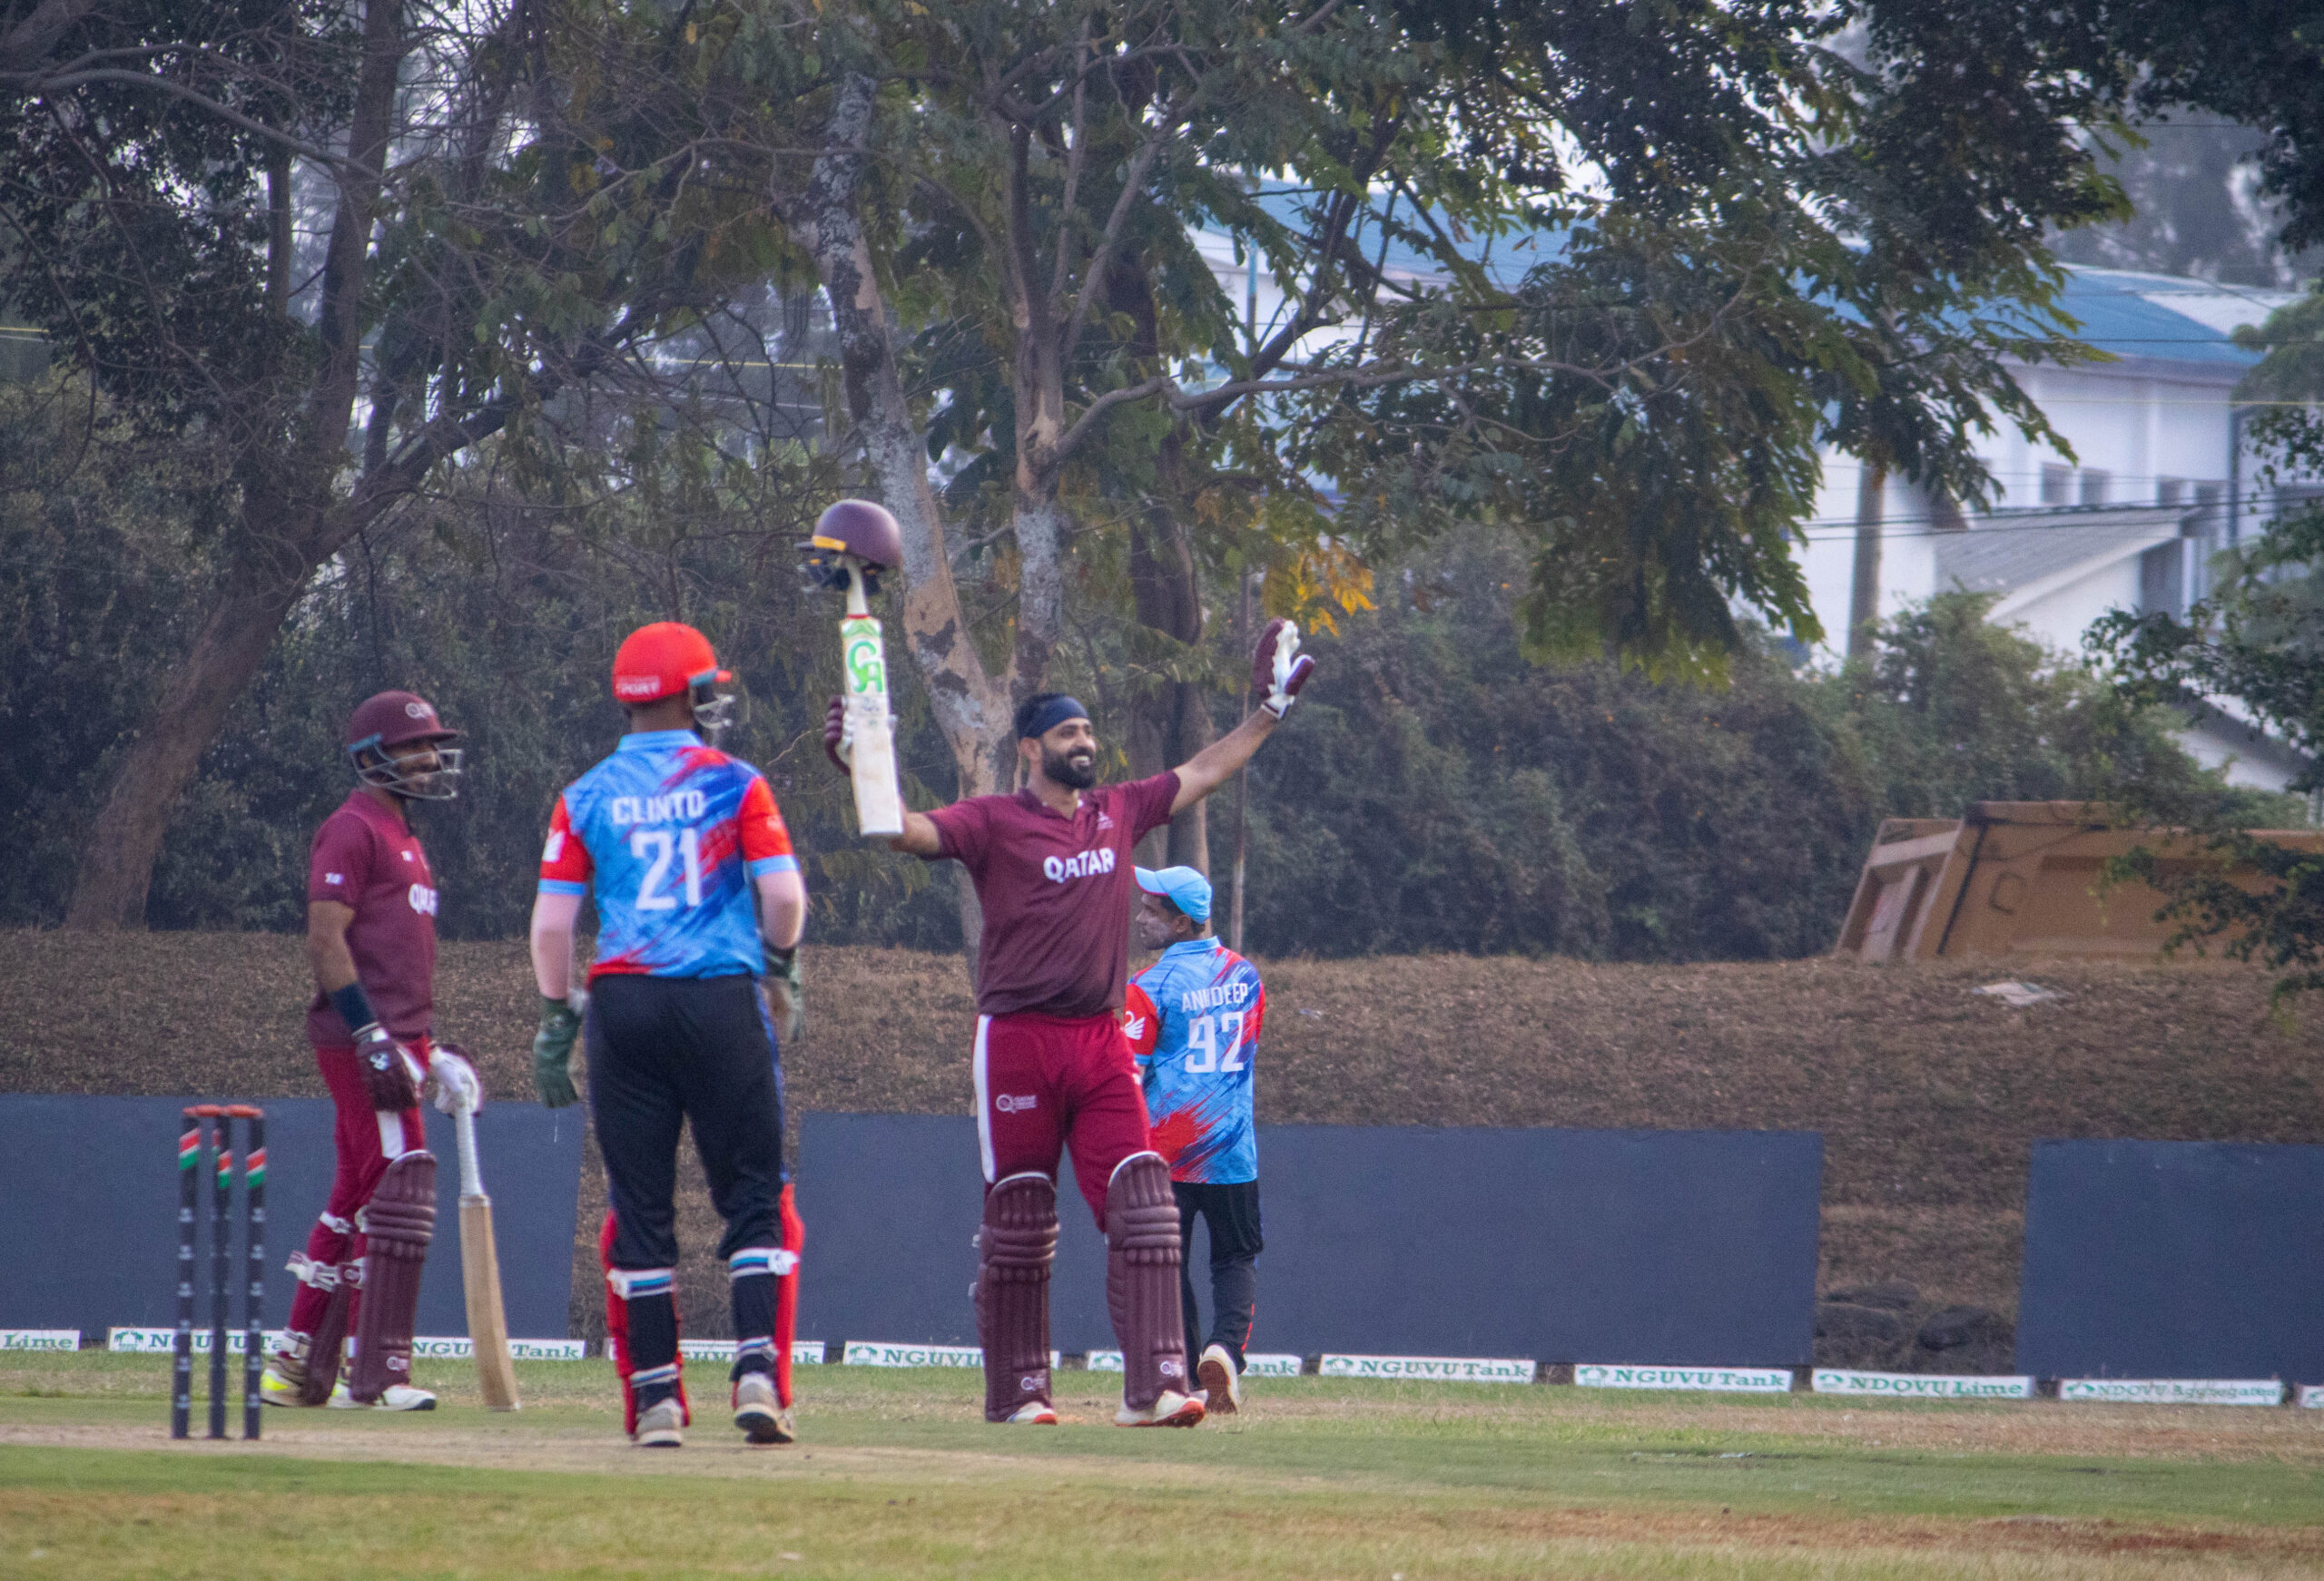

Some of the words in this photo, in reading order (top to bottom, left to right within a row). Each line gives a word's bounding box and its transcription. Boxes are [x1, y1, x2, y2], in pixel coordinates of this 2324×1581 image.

[612, 790, 704, 825] CLINTO
[629, 827, 702, 910] 21
[1043, 847, 1116, 885] QATAR
[1184, 1010, 1245, 1074] 92
[3, 1333, 74, 1349] Lime
[511, 1344, 579, 1359] Tank
[1246, 1360, 1296, 1375] ank
[1358, 1360, 1462, 1376] NGUVU
[1462, 1362, 1529, 1378] Tank
[1613, 1369, 1715, 1385] NGUVU
[1723, 1372, 1785, 1387] Tank
[1848, 1376, 1948, 1393] NDOVU
[1952, 1380, 2024, 1395] Lime
